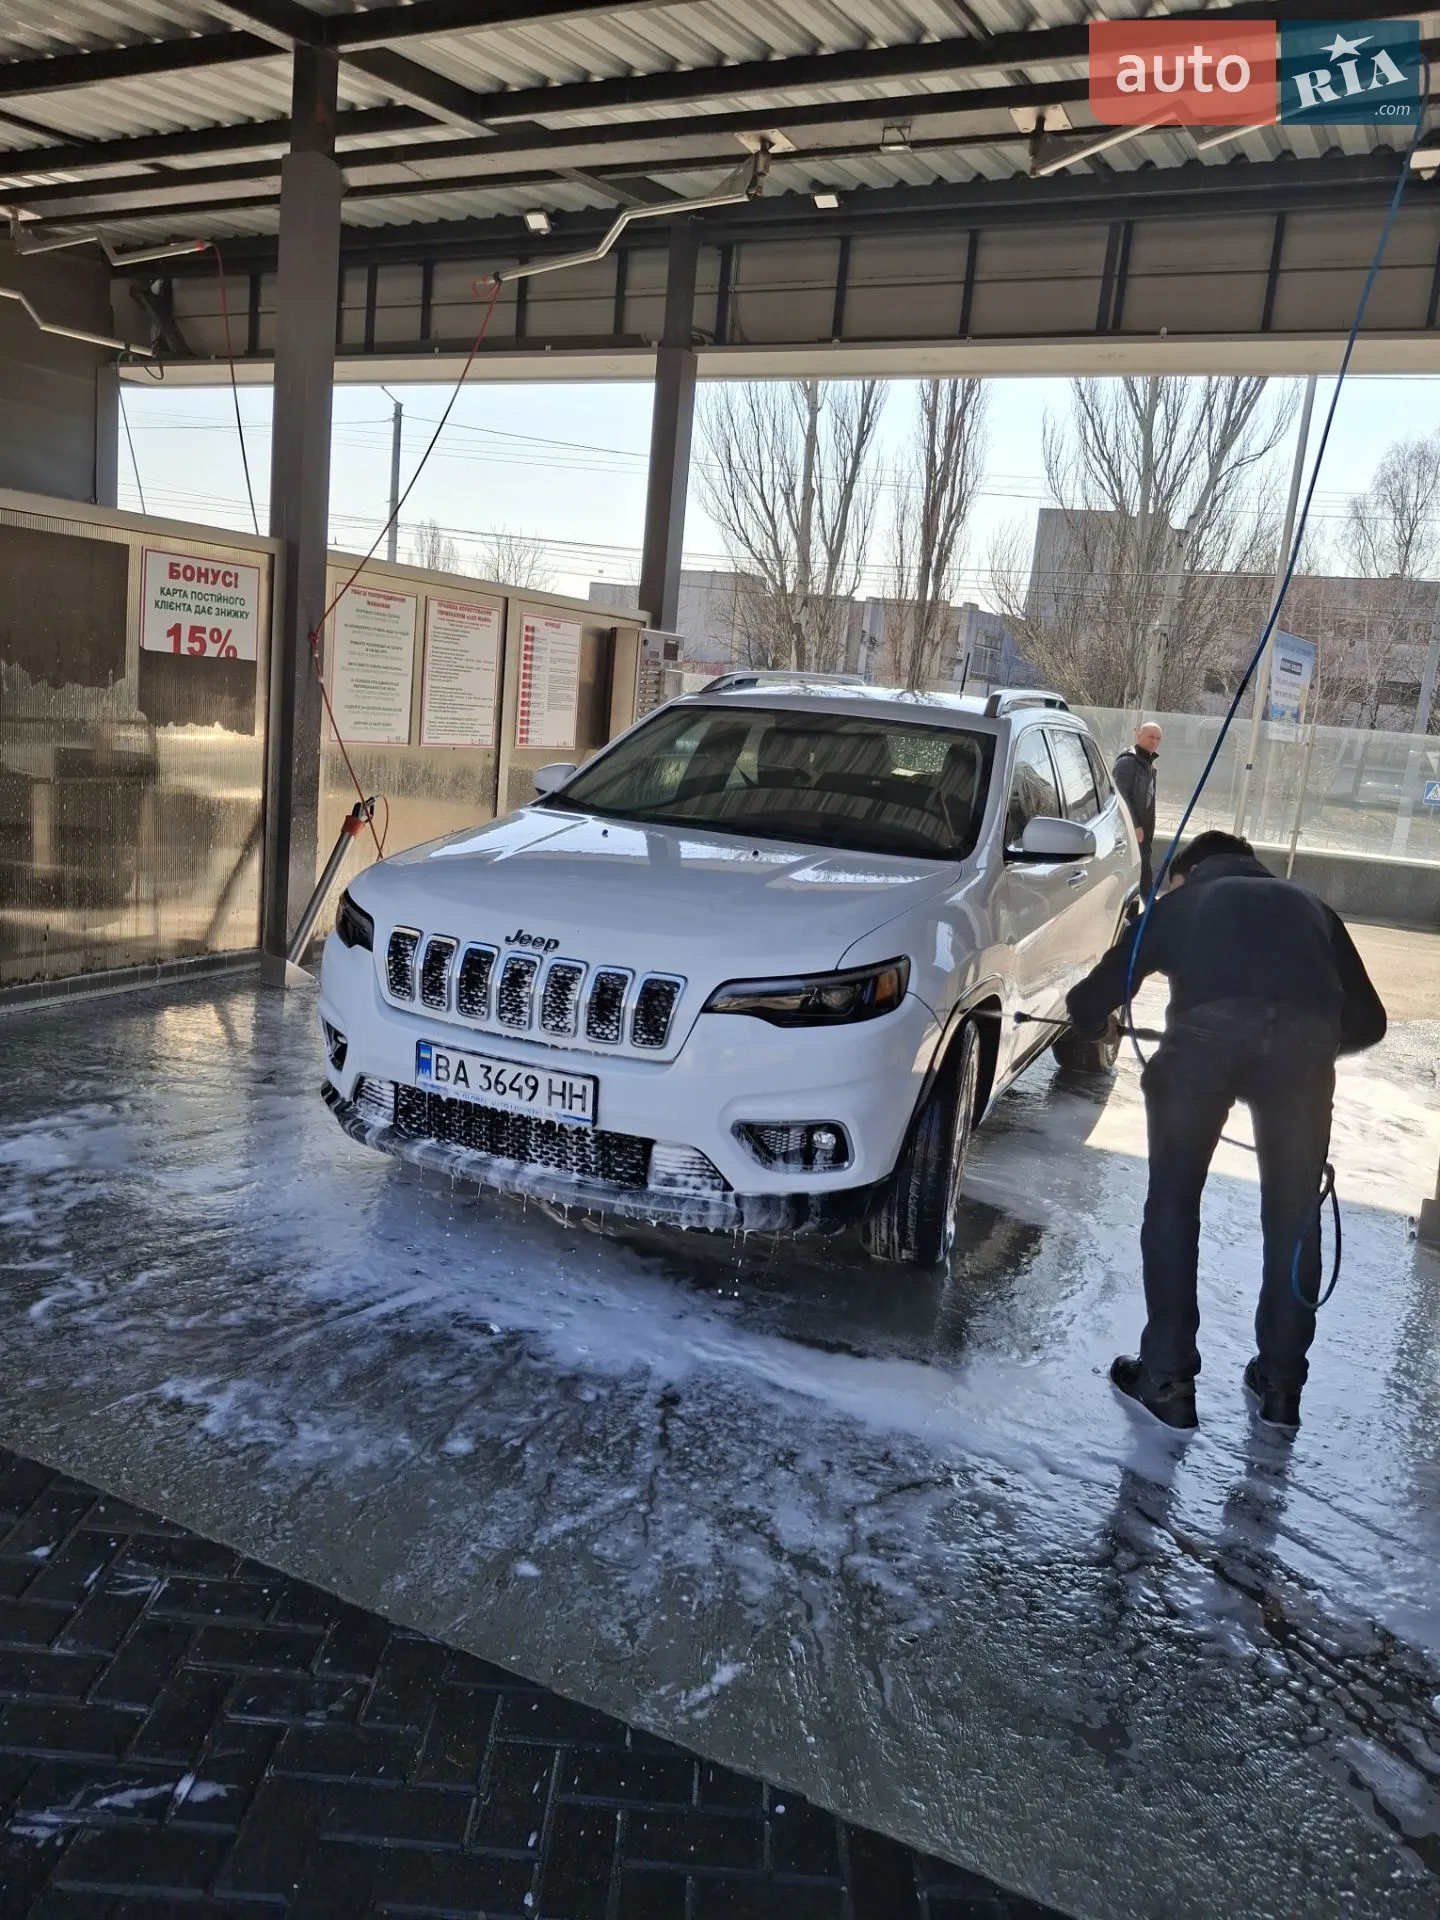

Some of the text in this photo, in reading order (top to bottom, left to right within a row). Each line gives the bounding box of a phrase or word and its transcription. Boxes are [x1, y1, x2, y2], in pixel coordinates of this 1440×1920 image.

[160, 586, 246, 607] КАРТА ПОСТІЙНОГО
[154, 600, 250, 620] КЛІЄНТА ДАЄ ЗНИЖКУ
[504, 928, 560, 954] Jeep
[435, 1053, 470, 1089] BA
[479, 1063, 540, 1102] 3649
[547, 1078, 588, 1113] HH
